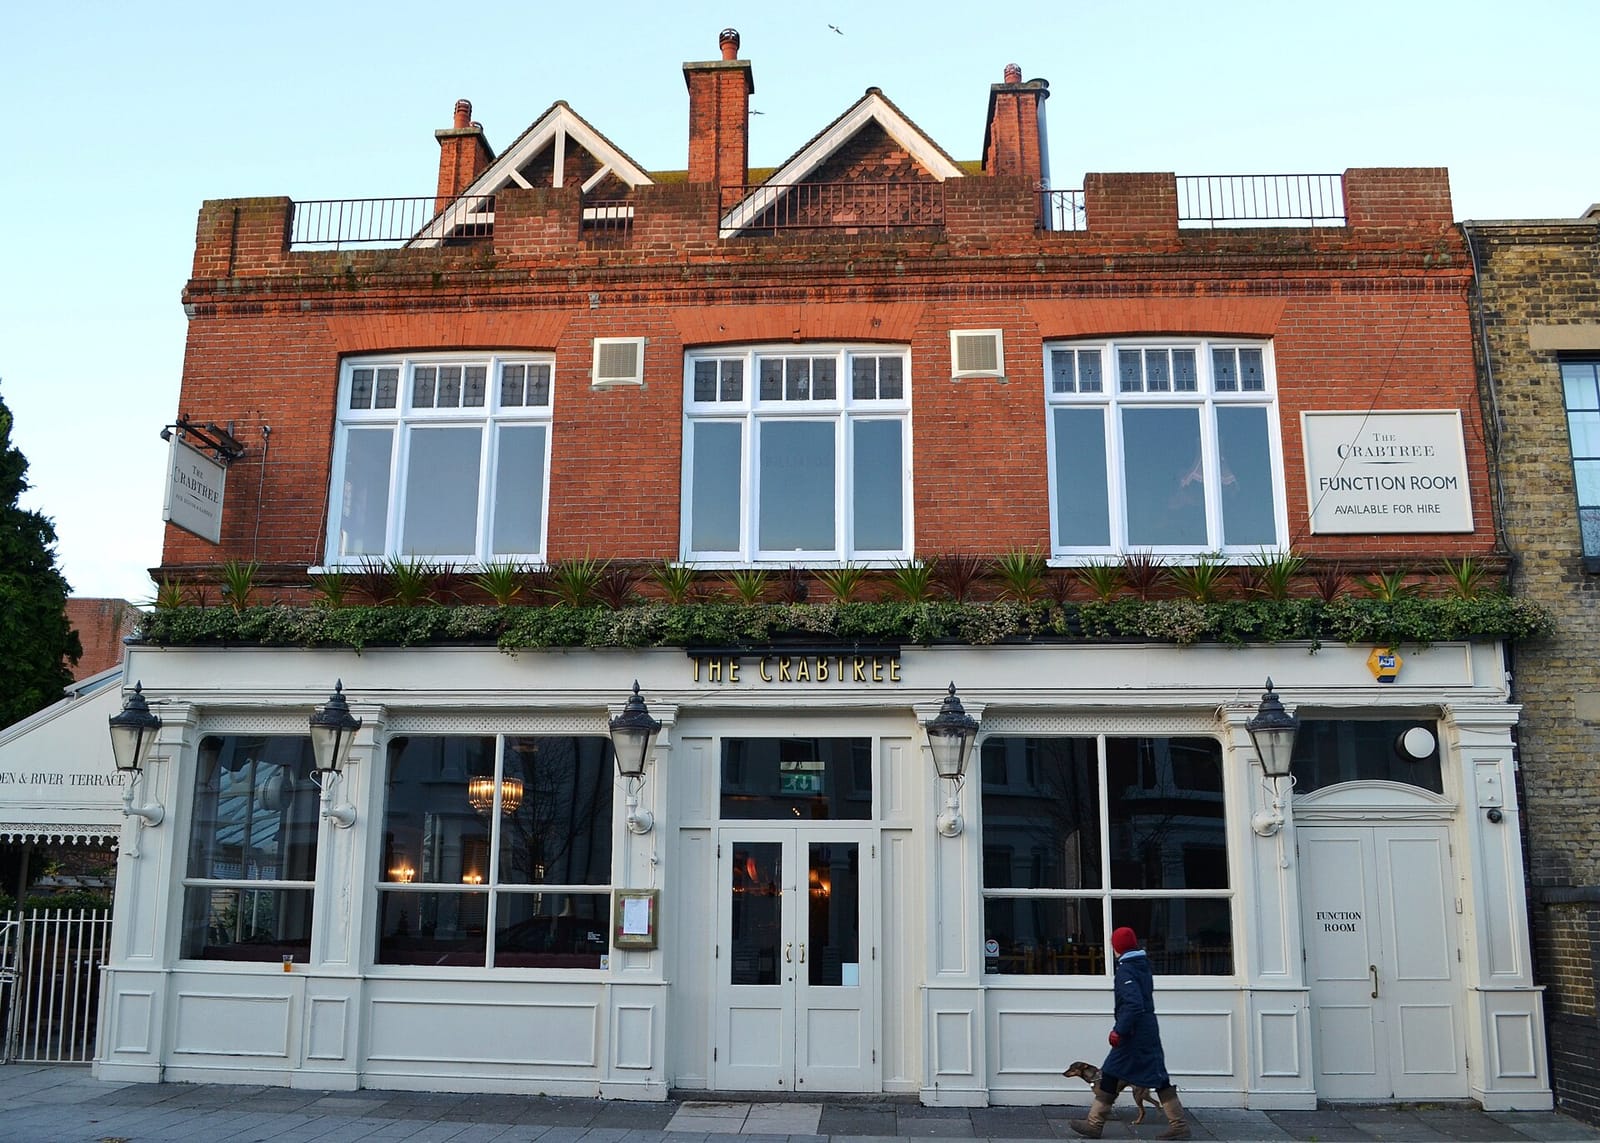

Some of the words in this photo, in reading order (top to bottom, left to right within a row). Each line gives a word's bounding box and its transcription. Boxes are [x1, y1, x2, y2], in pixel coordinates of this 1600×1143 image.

[1337, 443, 1435, 460] CRABTREE
[173, 466, 219, 503] CRABTREE
[1319, 476, 1406, 491] FUNCTION
[1410, 476, 1458, 490] ROOM
[1334, 505, 1389, 515] AVAILABLE
[1393, 505, 1414, 514] FOR
[1417, 504, 1441, 514] HIRE
[693, 656, 740, 682] THE
[759, 656, 902, 682] CRABTREE
[0, 772, 16, 785] EN
[18, 772, 28, 785] &
[30, 773, 64, 785] RIVER
[69, 774, 127, 787] TERRACE
[1316, 911, 1362, 920] FUNCTION
[1324, 923, 1356, 932] ROOM
